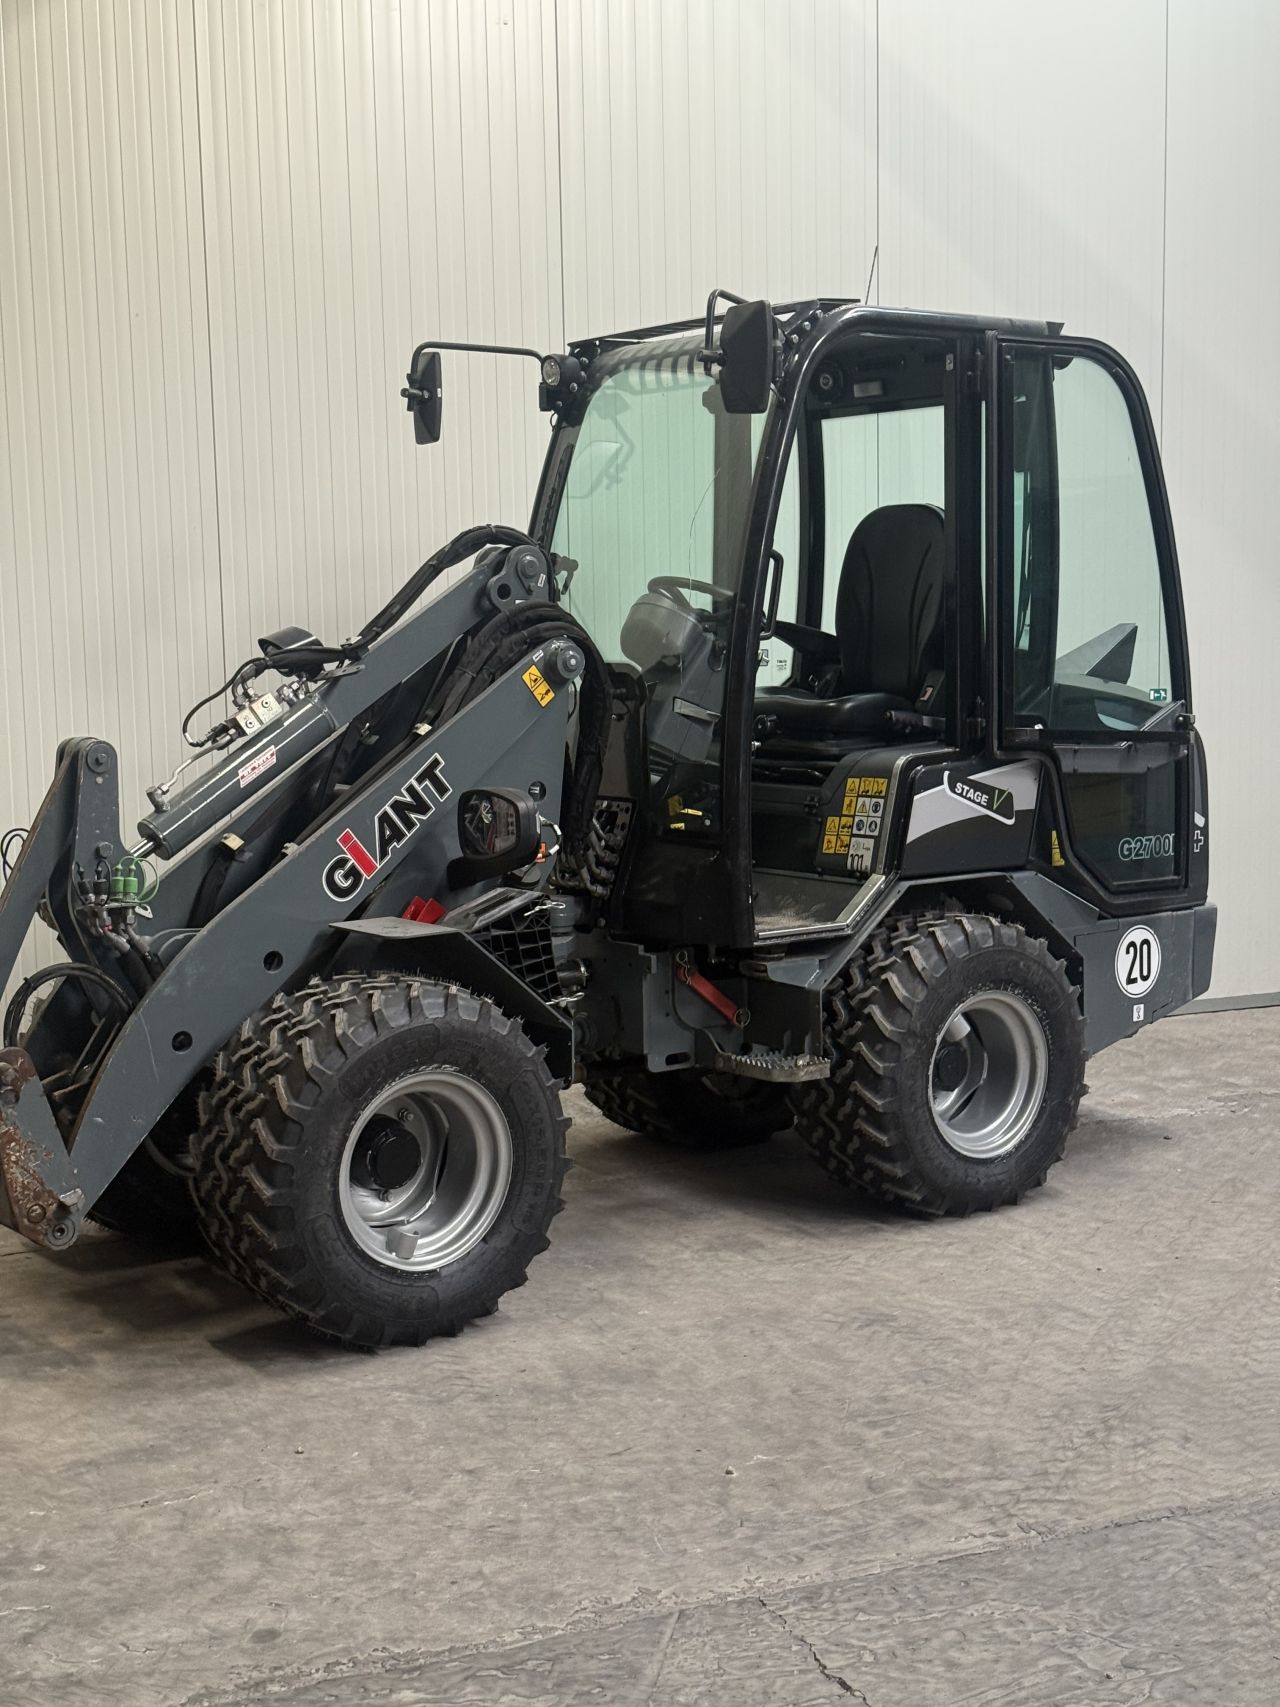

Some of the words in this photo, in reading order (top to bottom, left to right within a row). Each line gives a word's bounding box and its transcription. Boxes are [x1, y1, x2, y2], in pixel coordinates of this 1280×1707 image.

[954, 782, 989, 806] STAGE
[993, 787, 1009, 810] V
[1125, 938, 1151, 985] 20
